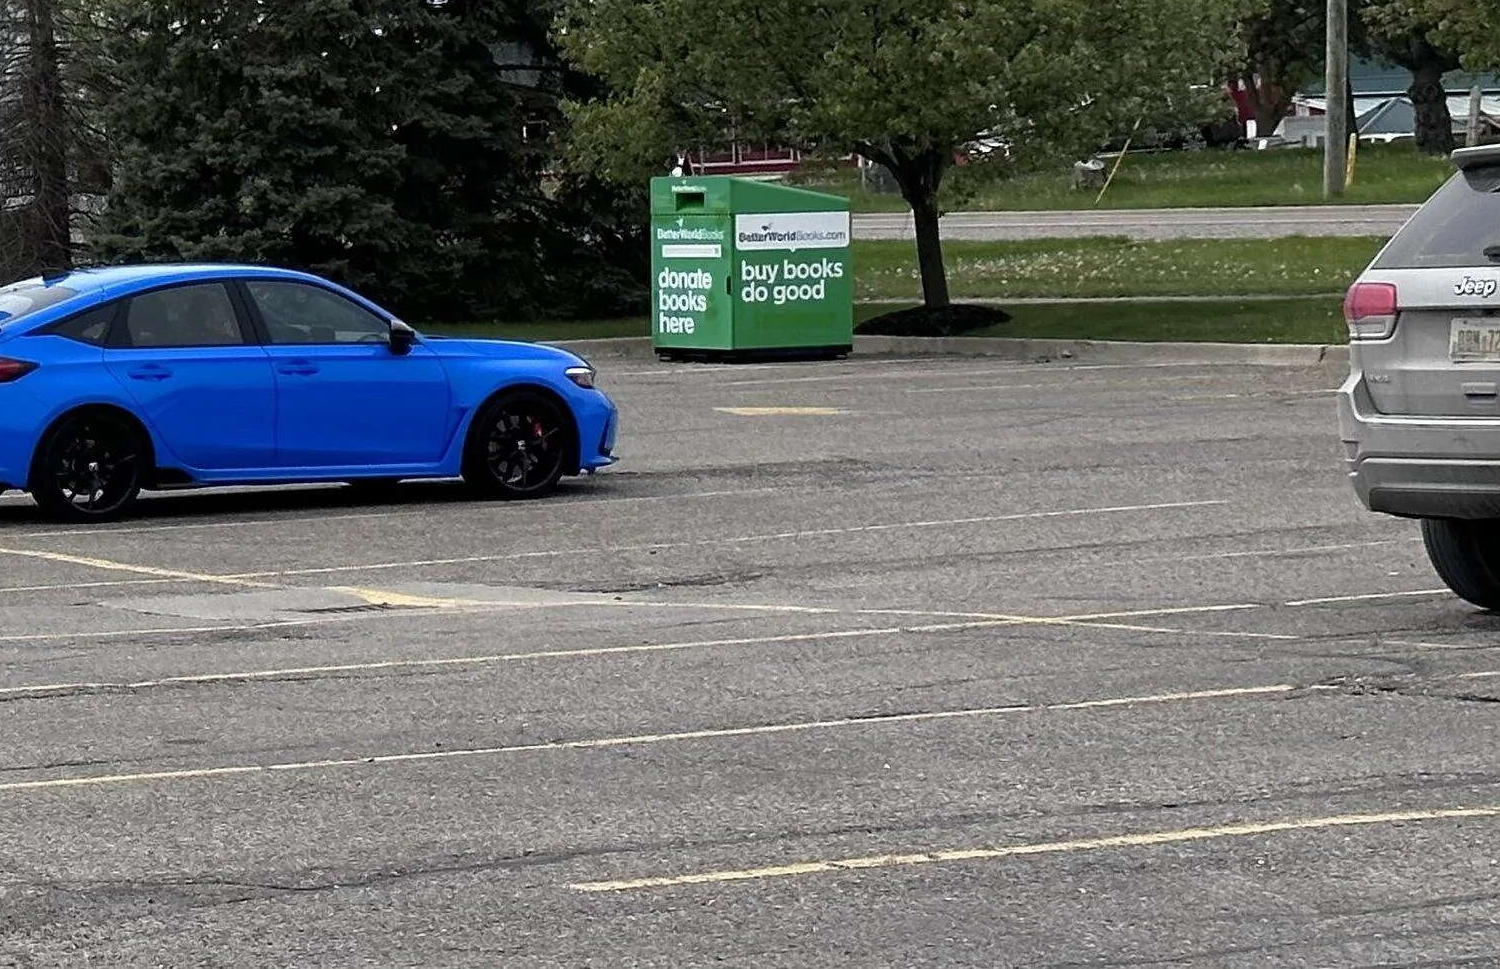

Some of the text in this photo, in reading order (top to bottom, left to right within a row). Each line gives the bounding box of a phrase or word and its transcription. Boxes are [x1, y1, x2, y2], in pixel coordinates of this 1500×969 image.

[738, 231, 846, 242] BetterWorldBooks.com
[658, 266, 712, 289] donate
[741, 257, 844, 284] buy books
[741, 279, 825, 305] do good
[1453, 276, 1497, 298] Jeep
[659, 289, 707, 312] books
[659, 311, 695, 334] here
